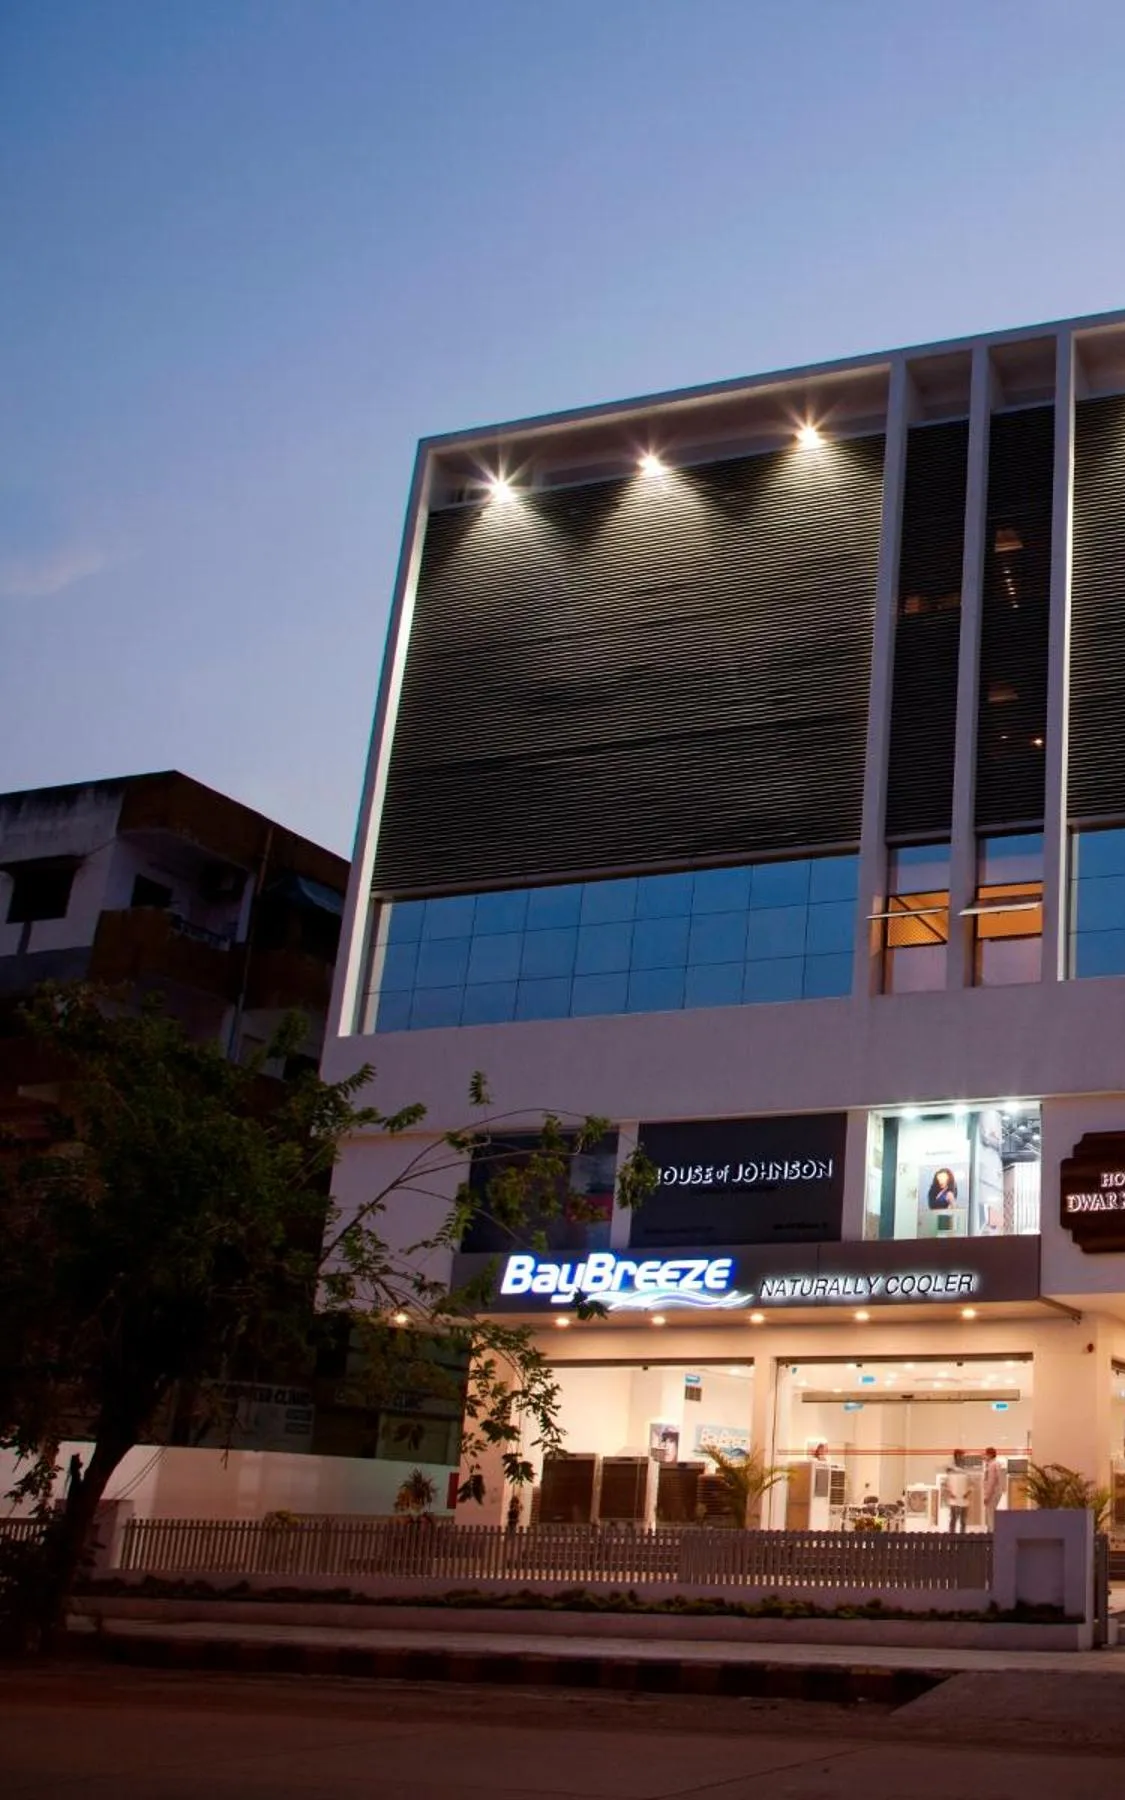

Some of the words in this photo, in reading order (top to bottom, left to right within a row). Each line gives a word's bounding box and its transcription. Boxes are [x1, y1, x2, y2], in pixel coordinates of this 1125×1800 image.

[716, 1164, 730, 1183] of
[731, 1159, 833, 1183] JOHNSON
[761, 1276, 881, 1297] NATURALLY
[886, 1274, 974, 1295] COOLER
